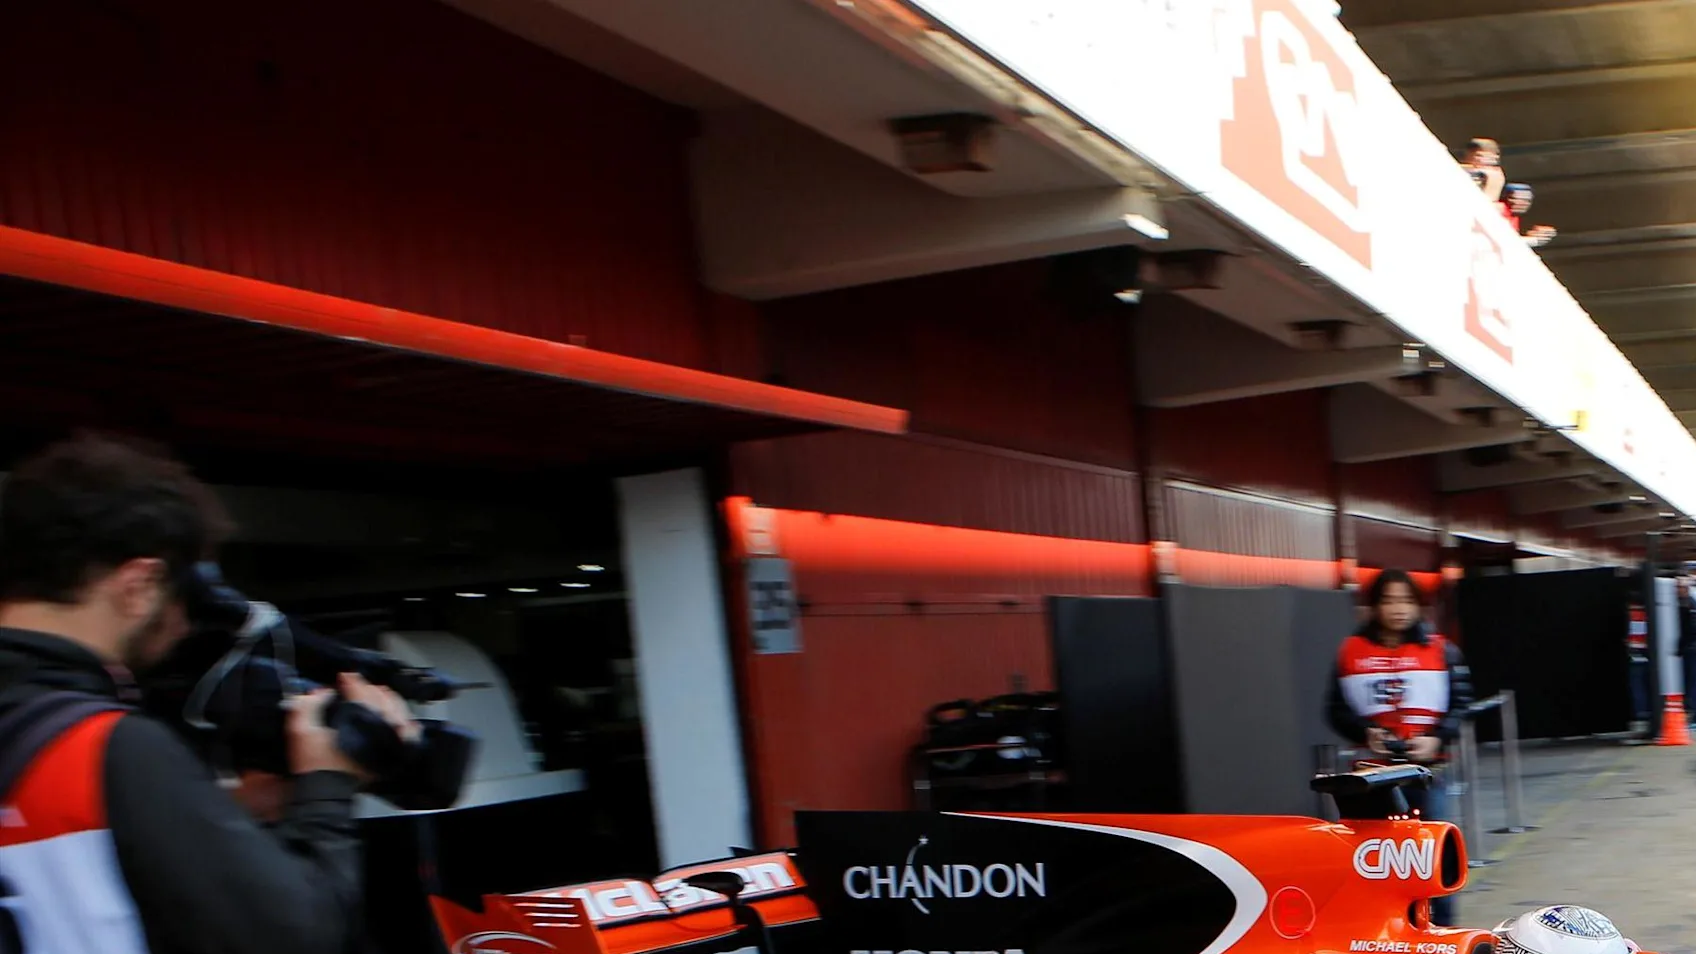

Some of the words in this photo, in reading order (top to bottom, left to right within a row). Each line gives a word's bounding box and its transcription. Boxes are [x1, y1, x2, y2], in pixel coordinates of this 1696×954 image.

[1353, 838, 1435, 880] CNN
[843, 862, 1046, 900] CHANDON
[1350, 940, 1412, 953] MICHAEL
